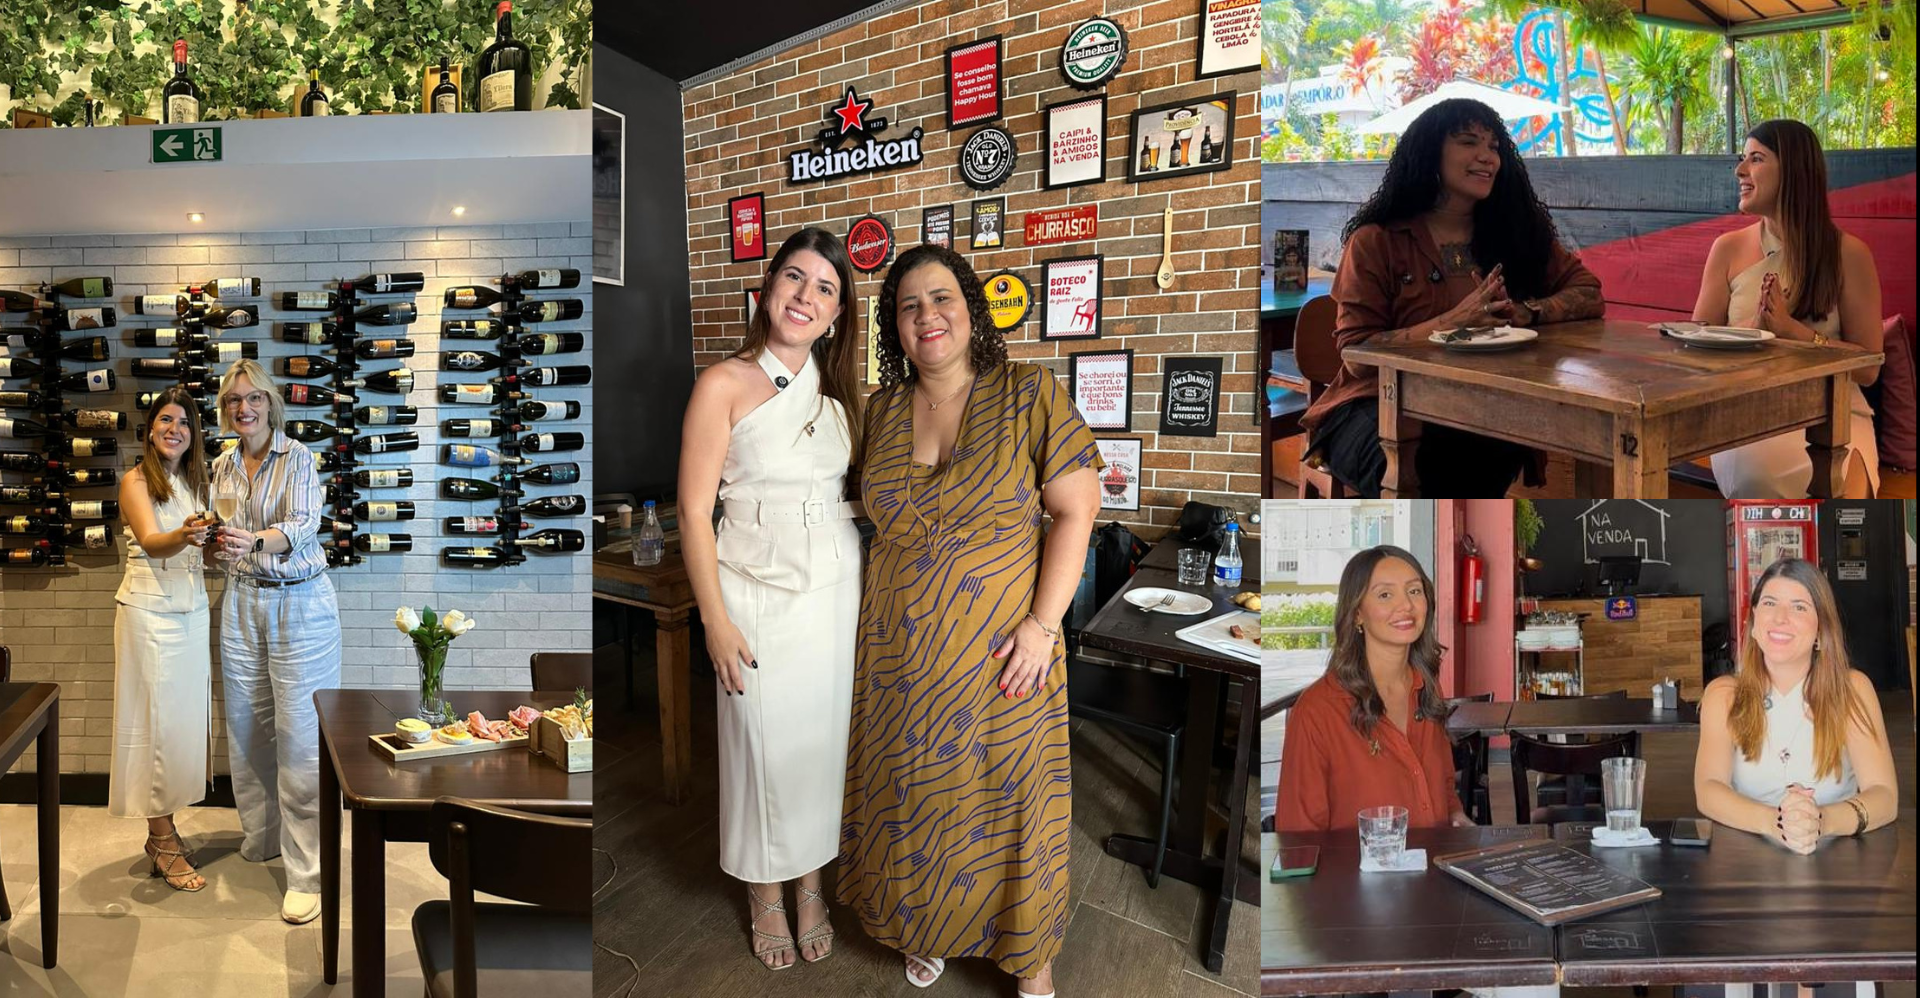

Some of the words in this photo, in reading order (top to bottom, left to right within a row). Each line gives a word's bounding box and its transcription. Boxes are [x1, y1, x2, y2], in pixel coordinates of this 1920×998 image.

[1210, 0, 1261, 12] VINAGR
[1210, 7, 1256, 21] RAPADURA
[1213, 16, 1252, 28] GENGIBRE
[1212, 23, 1250, 36] HORTELÃ
[1215, 32, 1247, 43] CEBOLA
[1222, 38, 1249, 49] LIMÃO
[1069, 43, 1116, 61] Heineken
[954, 72, 964, 80] Se
[964, 63, 997, 76] conselho
[957, 78, 976, 88] fosse
[976, 73, 994, 83] bom
[959, 83, 992, 96] chamava
[954, 95, 978, 106] Happy
[978, 91, 997, 101] Hour
[870, 120, 884, 129] 1873
[1060, 128, 1084, 140] CAIPI
[968, 136, 982, 154] JACK
[1053, 134, 1098, 149] BARZINHO
[1061, 142, 1098, 156] AMIGOS
[790, 138, 920, 181] Heineken
[1054, 157, 1066, 165] NA
[1068, 151, 1100, 162] VENDA
[1026, 216, 1095, 241] CHURRASCO
[849, 238, 886, 254] Budweiser
[1050, 276, 1087, 286] BOTECO
[1050, 286, 1071, 296] RAIZ
[990, 296, 1024, 310] SENBAHN
[1089, 371, 1115, 379] chorei
[1172, 376, 1188, 387] JACK
[1174, 402, 1206, 412] Tennessee
[1620, 434, 1639, 458] 12
[1590, 512, 1612, 528] NA
[1587, 528, 1632, 545] VENDA
